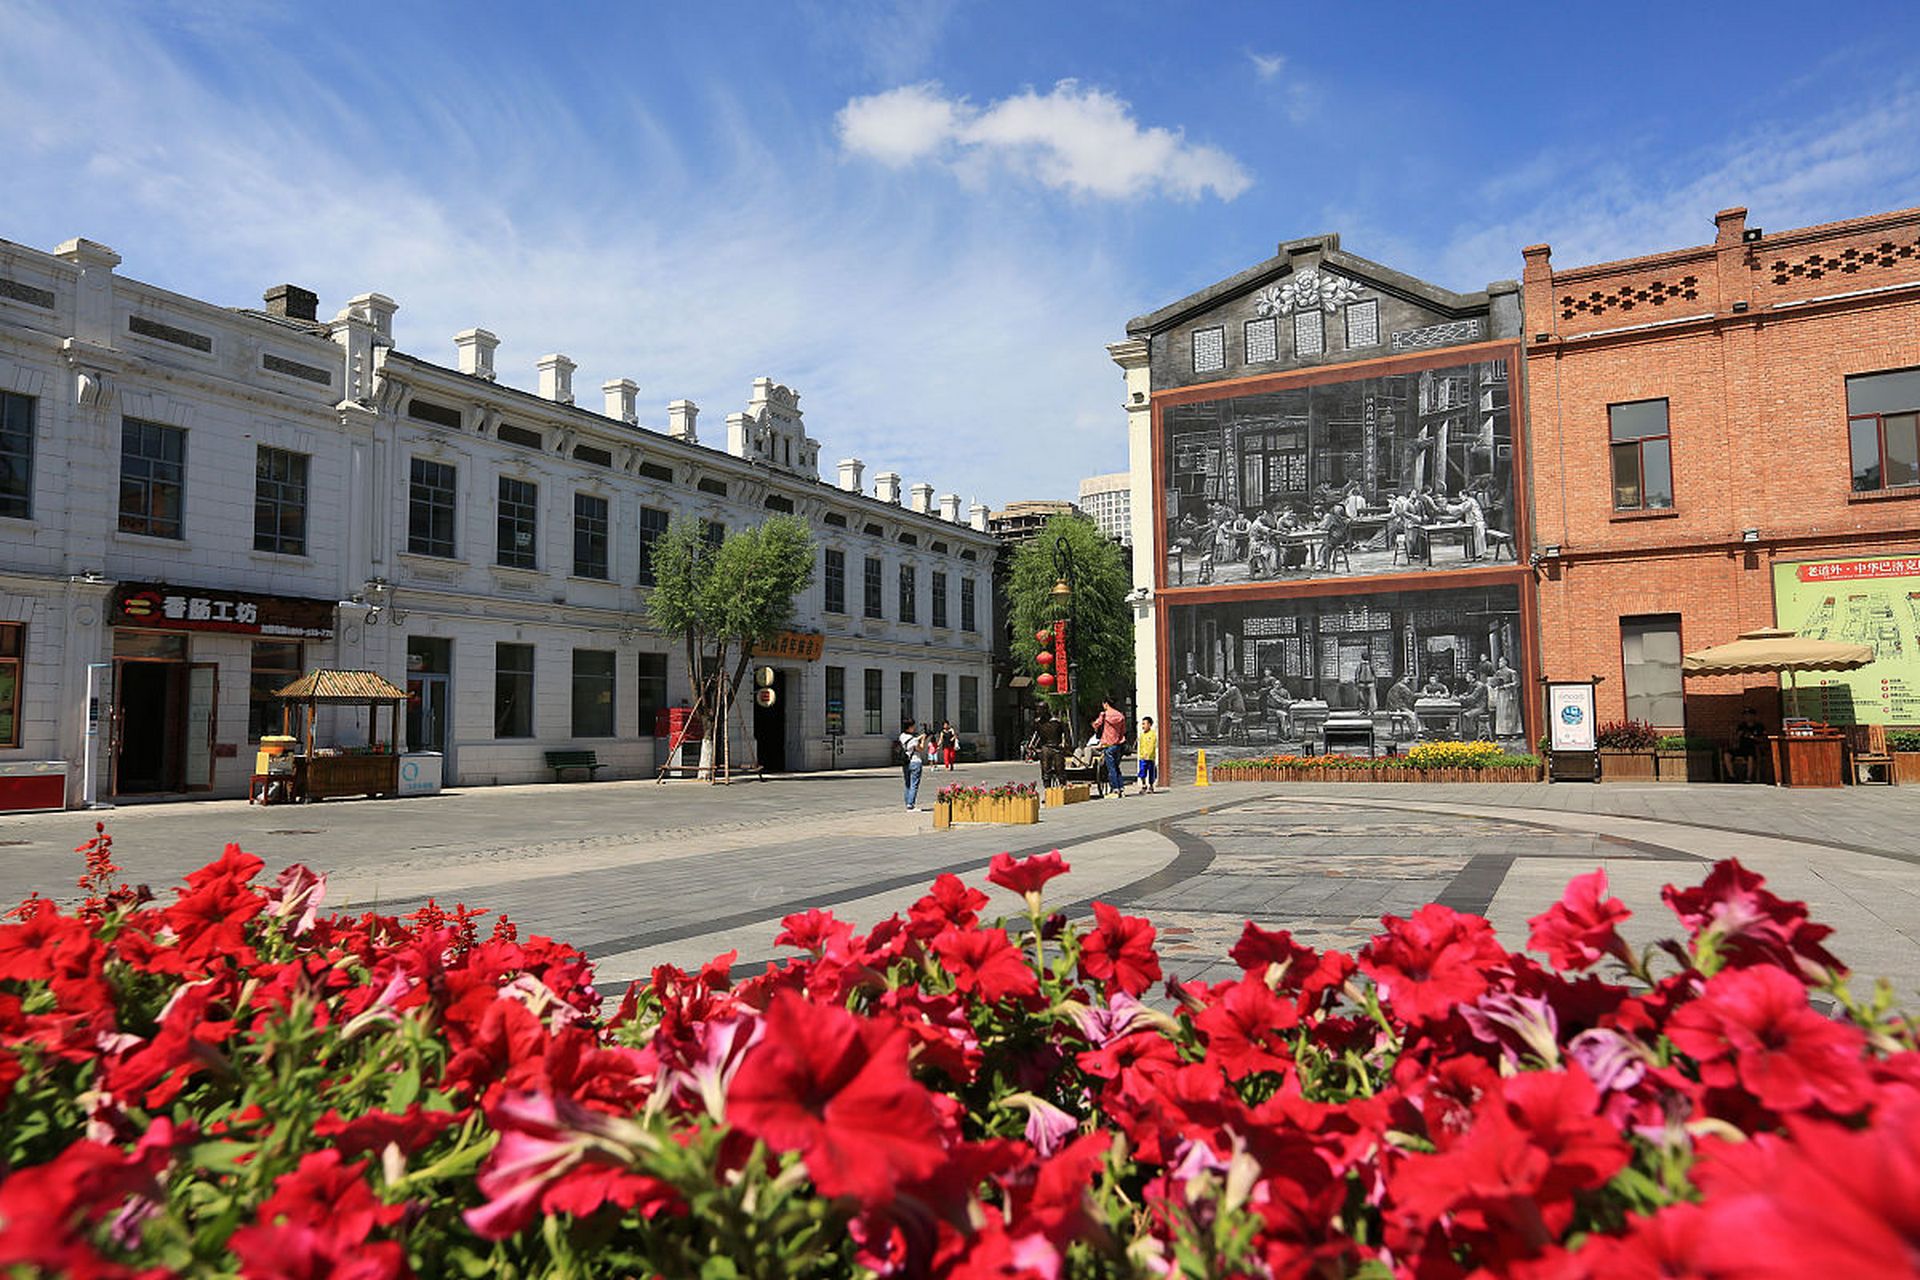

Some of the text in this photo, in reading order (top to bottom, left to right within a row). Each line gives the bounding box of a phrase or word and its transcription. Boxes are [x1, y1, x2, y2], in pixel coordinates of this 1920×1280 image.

[1807, 559, 1920, 578] 老道外·中华巴洛克
[161, 596, 258, 624] 香肠工坊
